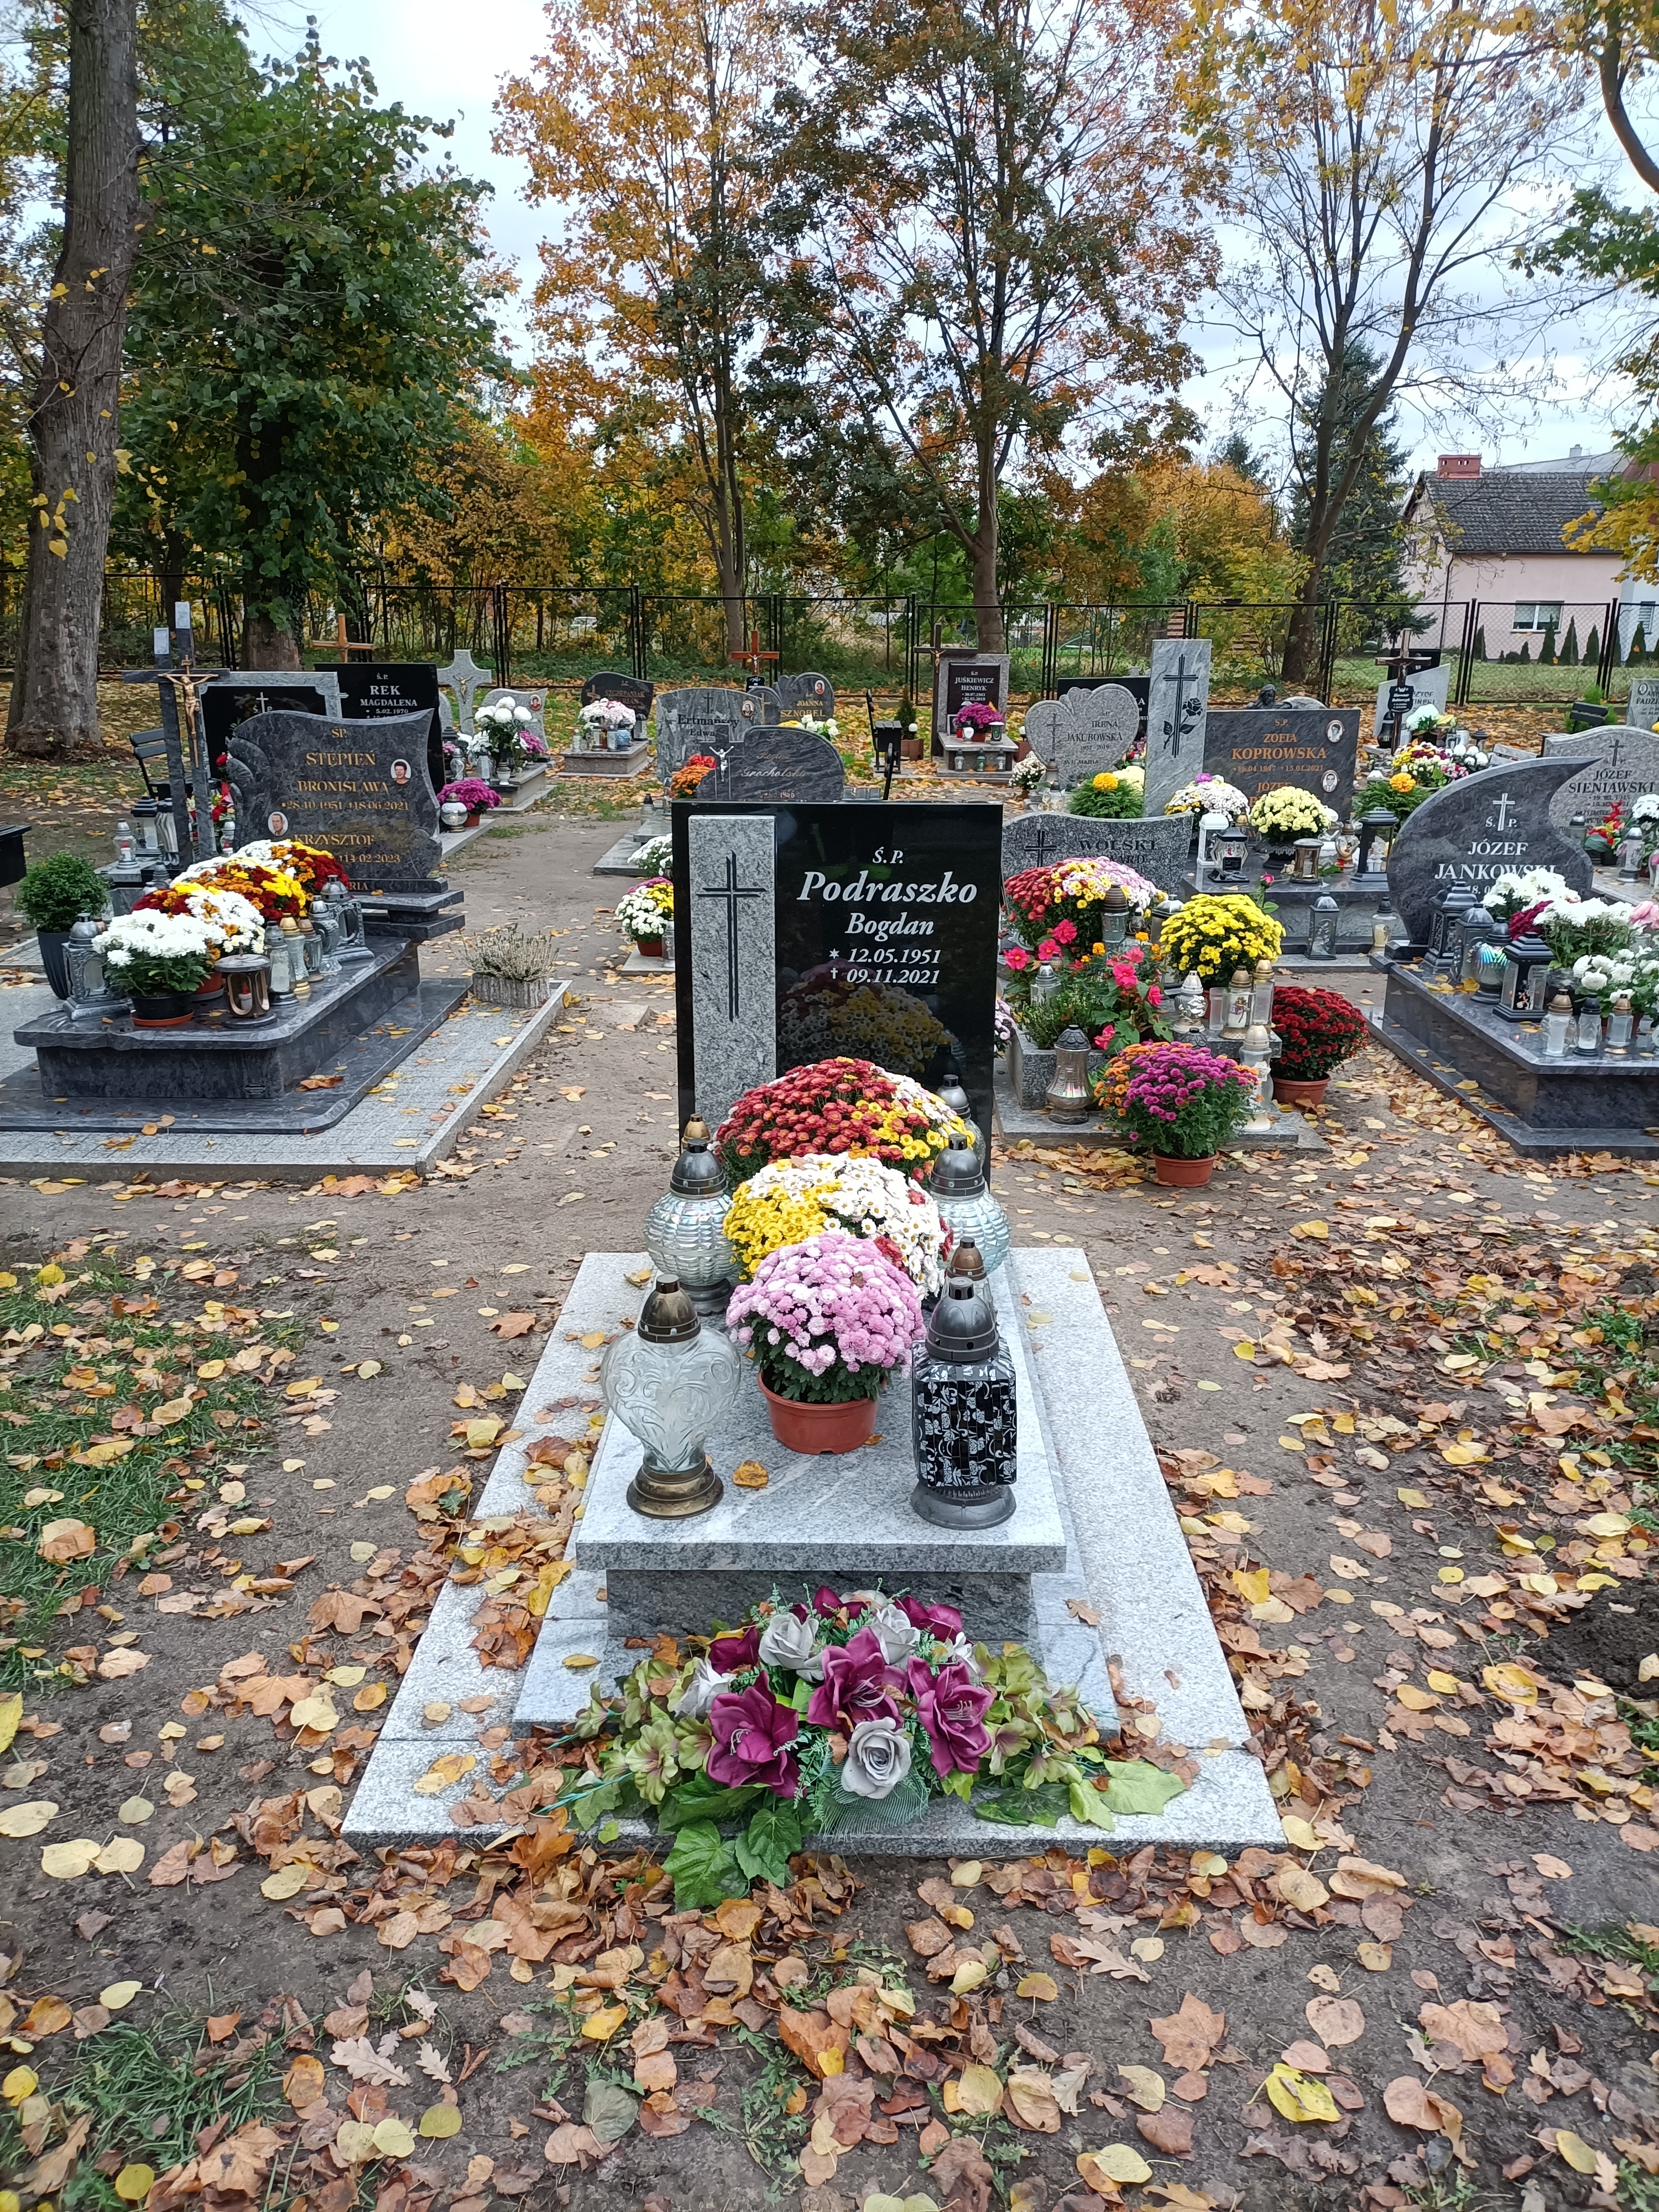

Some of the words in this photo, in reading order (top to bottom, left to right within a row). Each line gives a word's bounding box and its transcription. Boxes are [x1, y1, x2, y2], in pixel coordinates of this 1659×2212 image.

[369, 685, 401, 695] REK
[689, 728, 716, 737] Edwa
[1068, 732, 1123, 742] JAKUBOWSKA
[1263, 733, 1297, 743] ZOFIA
[1231, 747, 1327, 760] KOPROWSKA
[1593, 768, 1632, 781] JÓZEF
[1568, 781, 1655, 793] SIENIAWSKI
[294, 834, 375, 845] KRZYSZTOF
[1078, 839, 1157, 851] WOLSKI
[1467, 838, 1529, 855] JÓZEF
[796, 870, 977, 903] Podraszko
[844, 912, 934, 942] Bogdan
[847, 948, 941, 964] 12.05.1951
[847, 968, 940, 984] 09.11.2021
